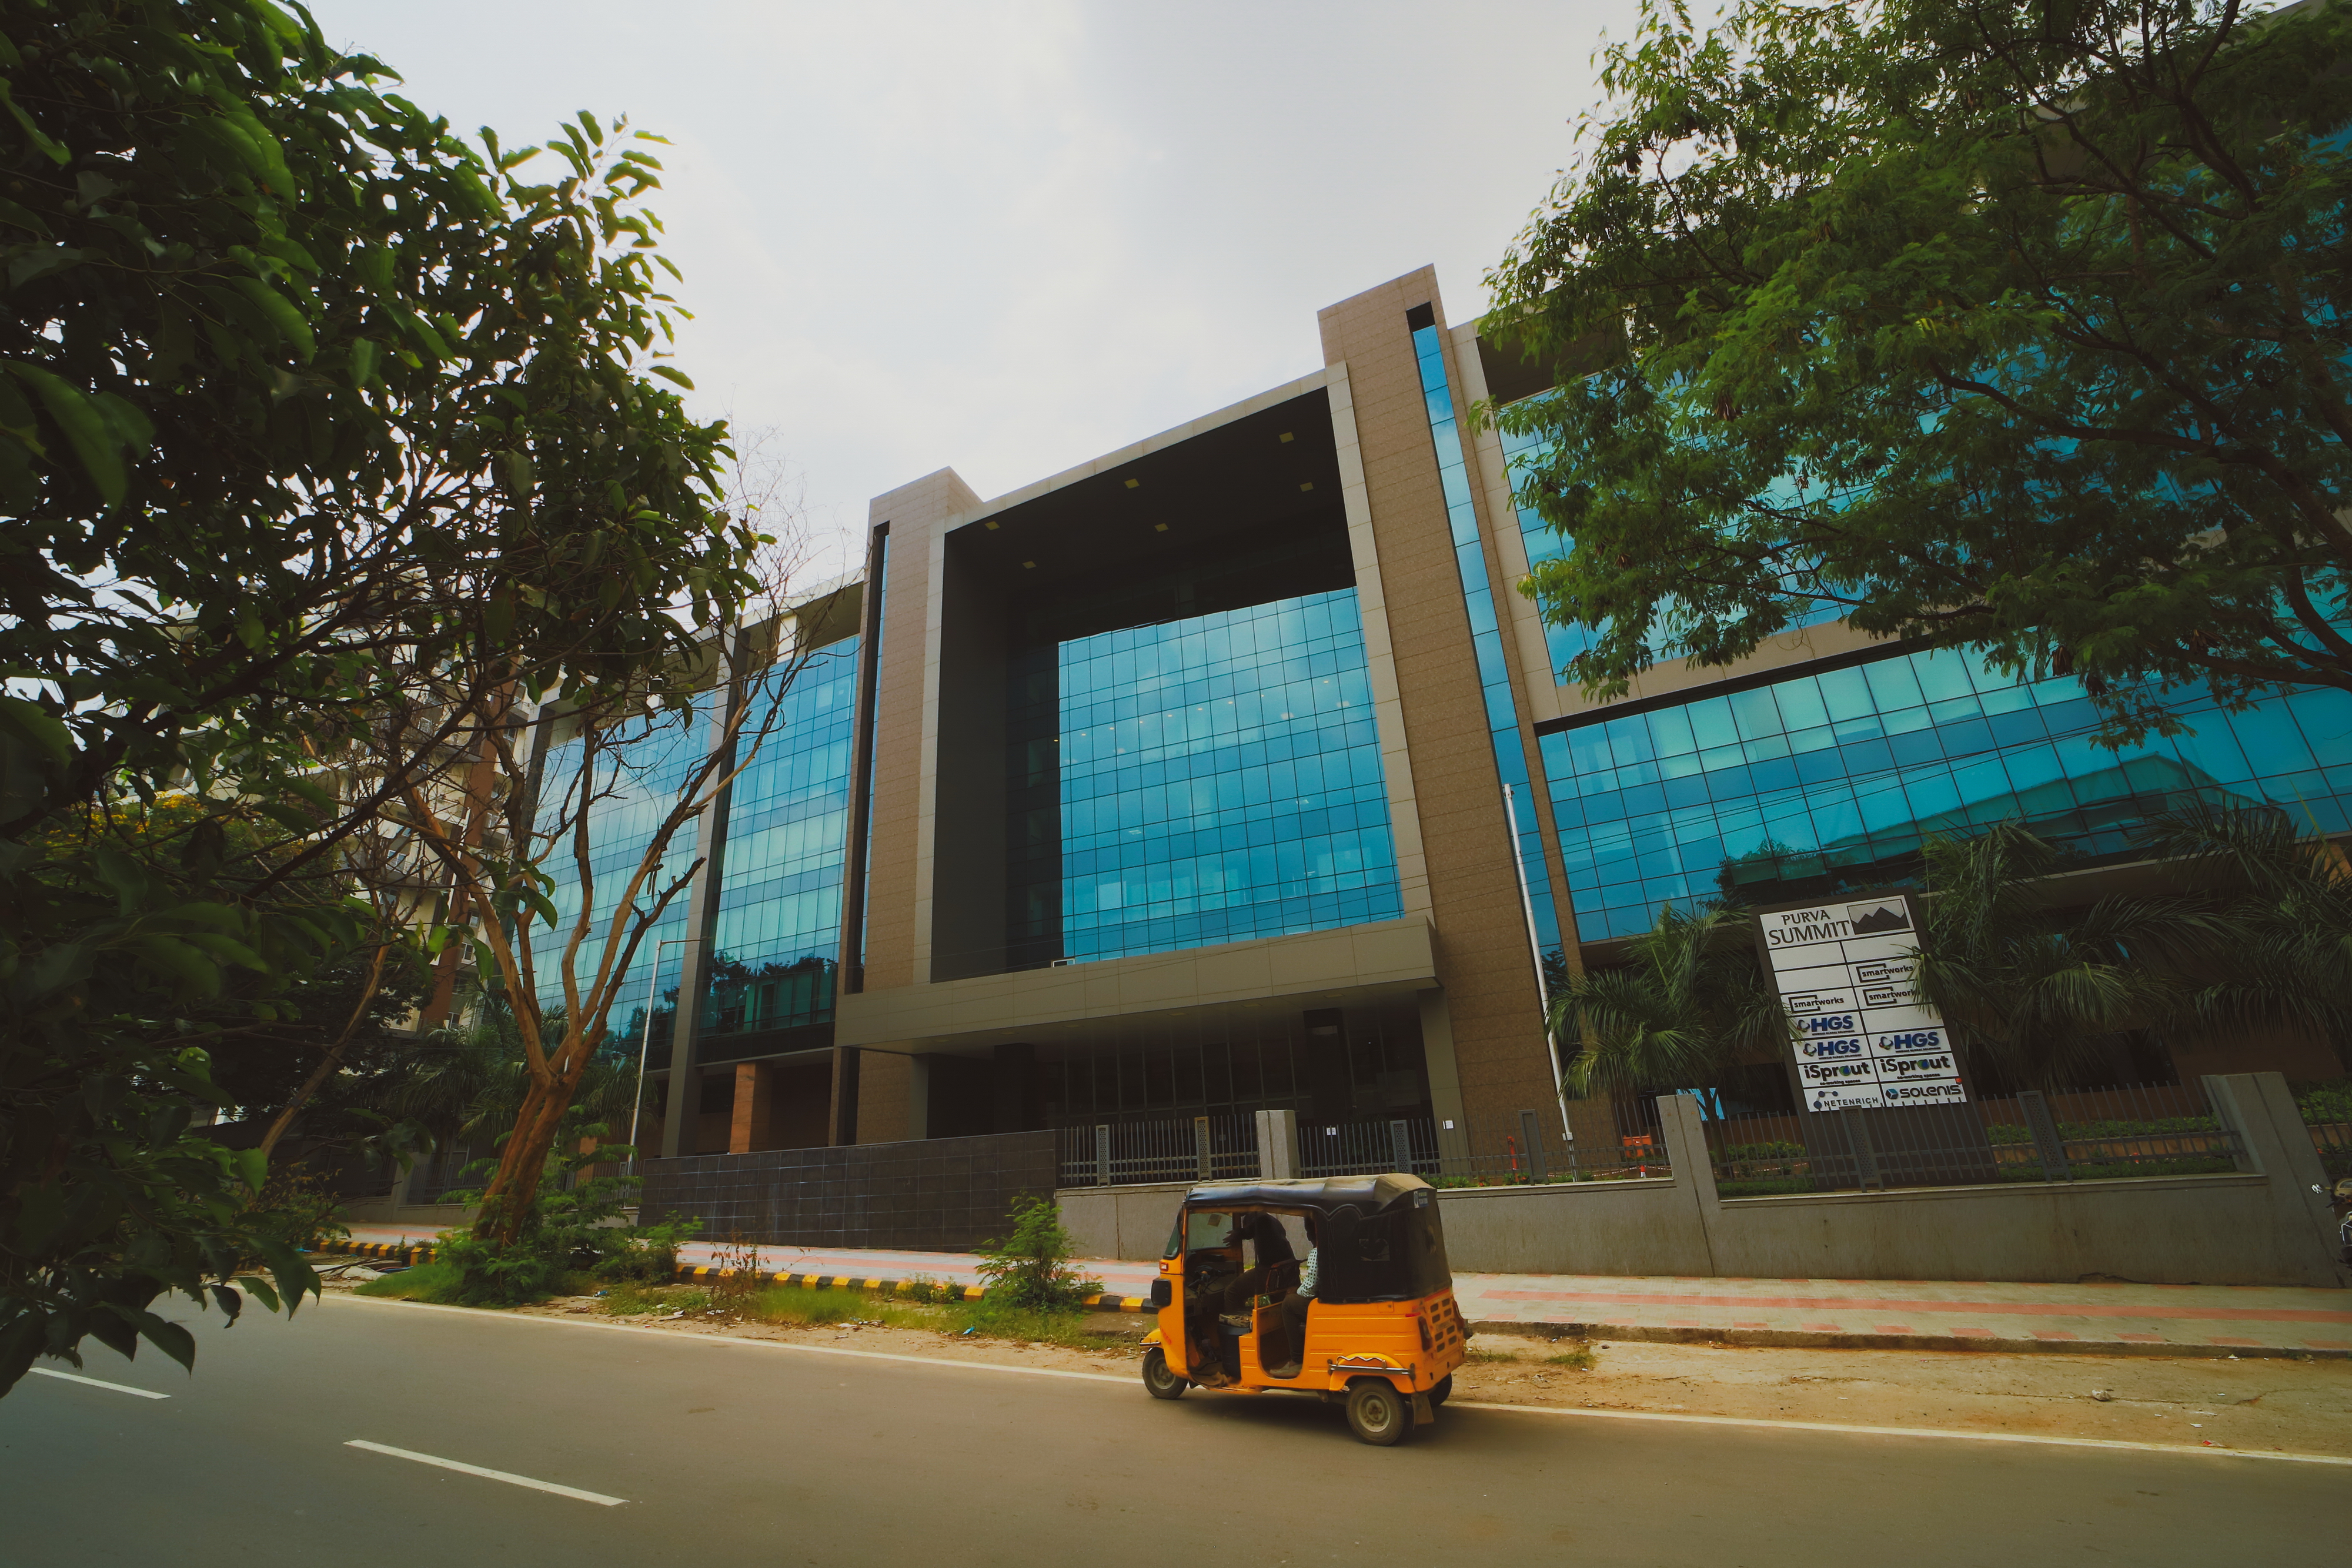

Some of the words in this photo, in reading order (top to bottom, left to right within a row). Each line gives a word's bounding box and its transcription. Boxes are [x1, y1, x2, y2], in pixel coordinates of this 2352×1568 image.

[1780, 909, 1831, 926] PURVA
[1768, 920, 1850, 945] SUMMIT
[1862, 965, 1914, 977] smartworks
[1793, 997, 1844, 1008] smartworks
[1869, 988, 1916, 1001] smartwork
[1811, 1015, 1853, 1032] HGS
[1817, 1039, 1860, 1056] HGS
[1894, 1031, 1939, 1049] HGS
[1803, 1062, 1870, 1081] iSprout
[1880, 1056, 1950, 1075] iSprout
[1824, 1097, 1879, 1107] NETENRICH
